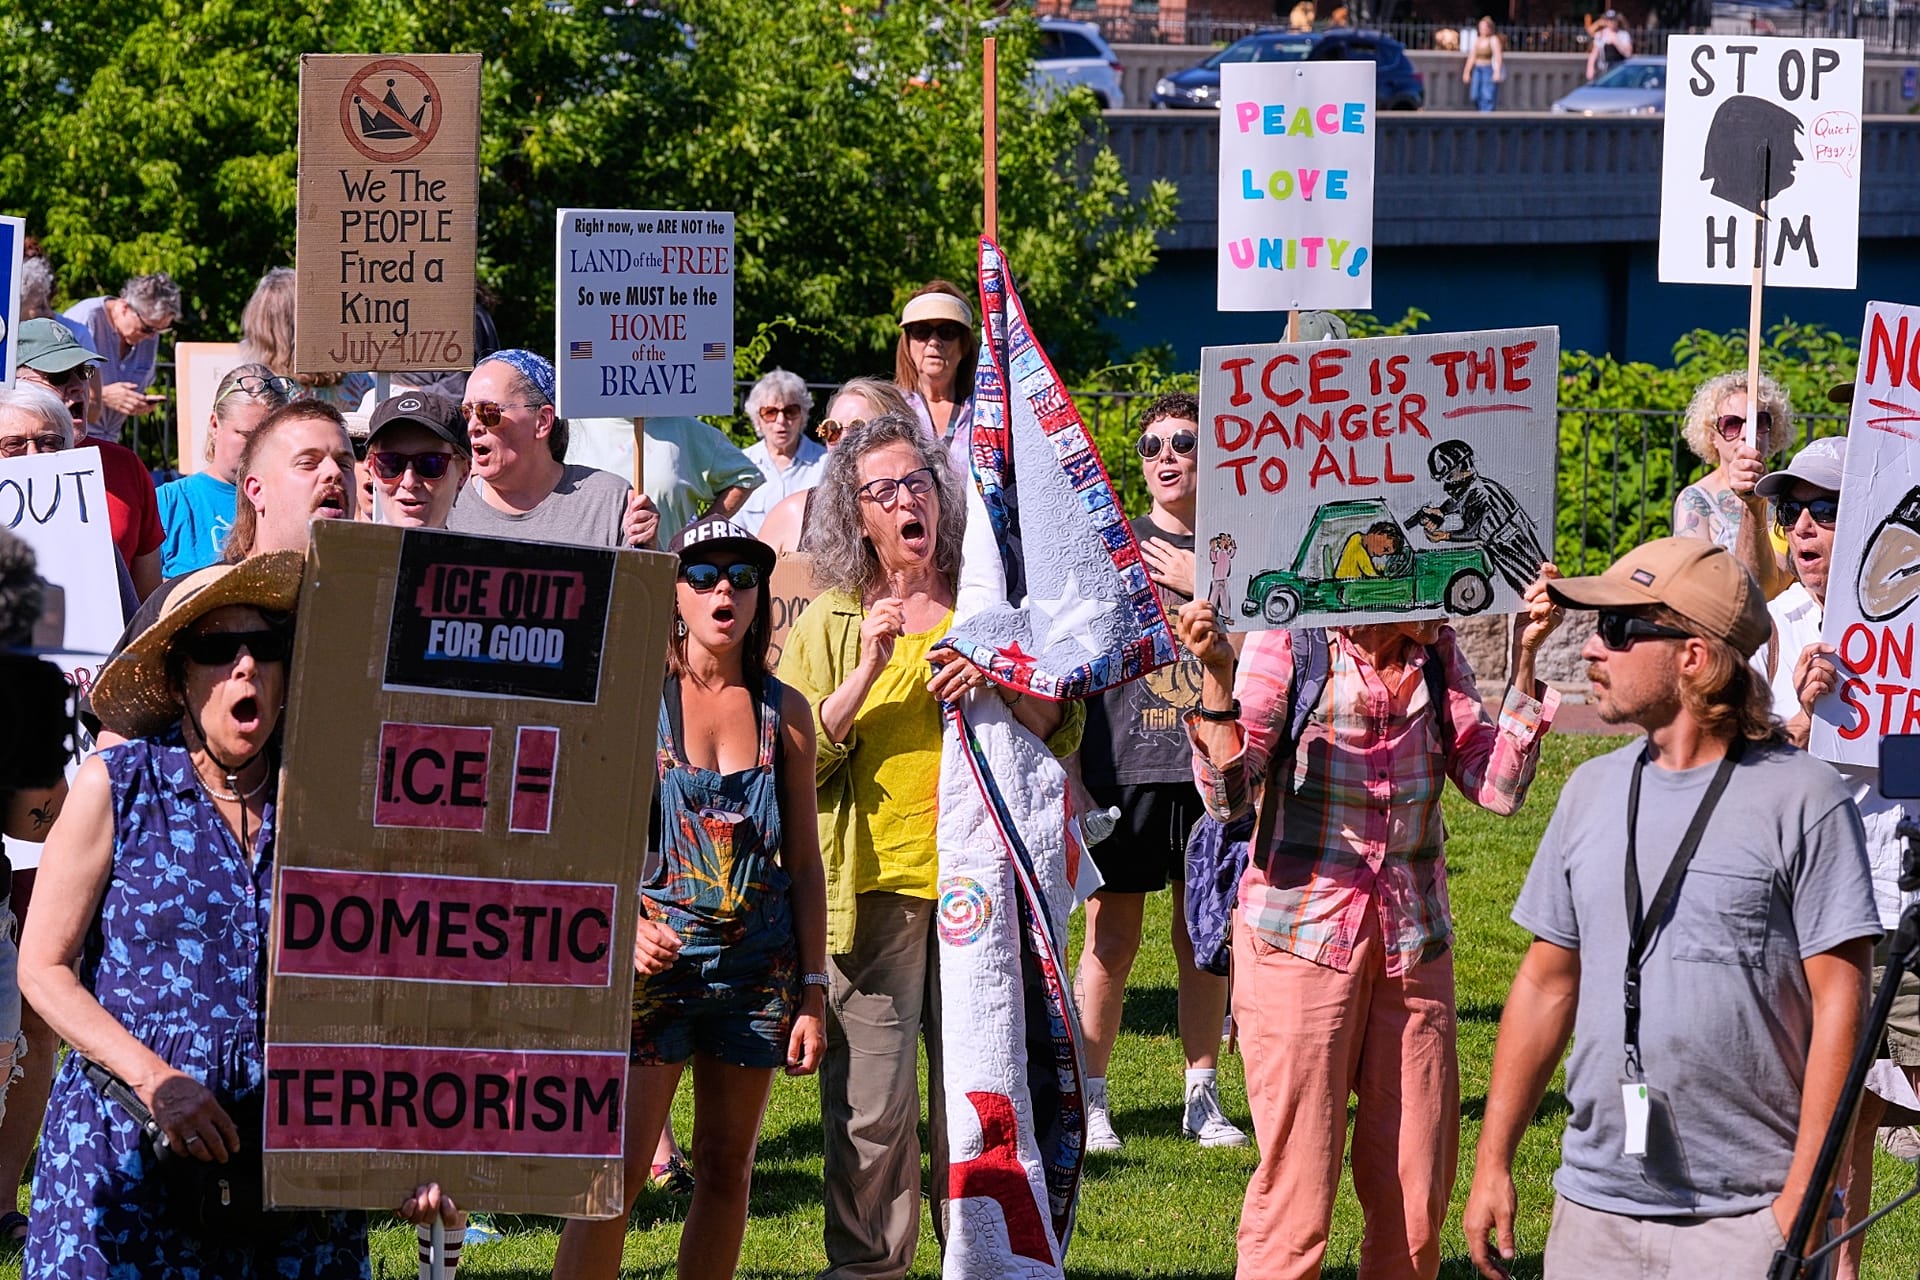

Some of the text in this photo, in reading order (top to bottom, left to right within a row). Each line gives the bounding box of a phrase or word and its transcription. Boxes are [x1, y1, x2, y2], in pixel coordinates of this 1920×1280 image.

[1689, 45, 1840, 101] STOP
[1236, 102, 1365, 138] PEACE
[1815, 117, 1856, 138] Quiet
[339, 169, 446, 203] We The
[1242, 168, 1348, 201] LOVE
[340, 209, 453, 244] PEOPLE
[575, 218, 725, 237] Right now, we ARE NOT the
[340, 250, 444, 284] Fired a
[570, 246, 729, 274] LAND of the FREE
[1228, 237, 1368, 277] UNITY!
[578, 285, 717, 306] So we MUST be the
[340, 291, 410, 338] King
[610, 313, 687, 341] HOME
[328, 331, 388, 370] July
[632, 343, 666, 361] of the
[600, 363, 697, 397] BRAVE
[1220, 340, 1538, 407] ICE IS THE
[1214, 393, 1433, 452] DANGER
[1215, 442, 1415, 496] TO ALL
[431, 567, 574, 620] ICE OUT
[428, 620, 565, 664] FOR GOOD
[381, 747, 488, 808] I.C.E.
[284, 893, 609, 964] DOMESTIC
[268, 1069, 620, 1133] TERRORISM
